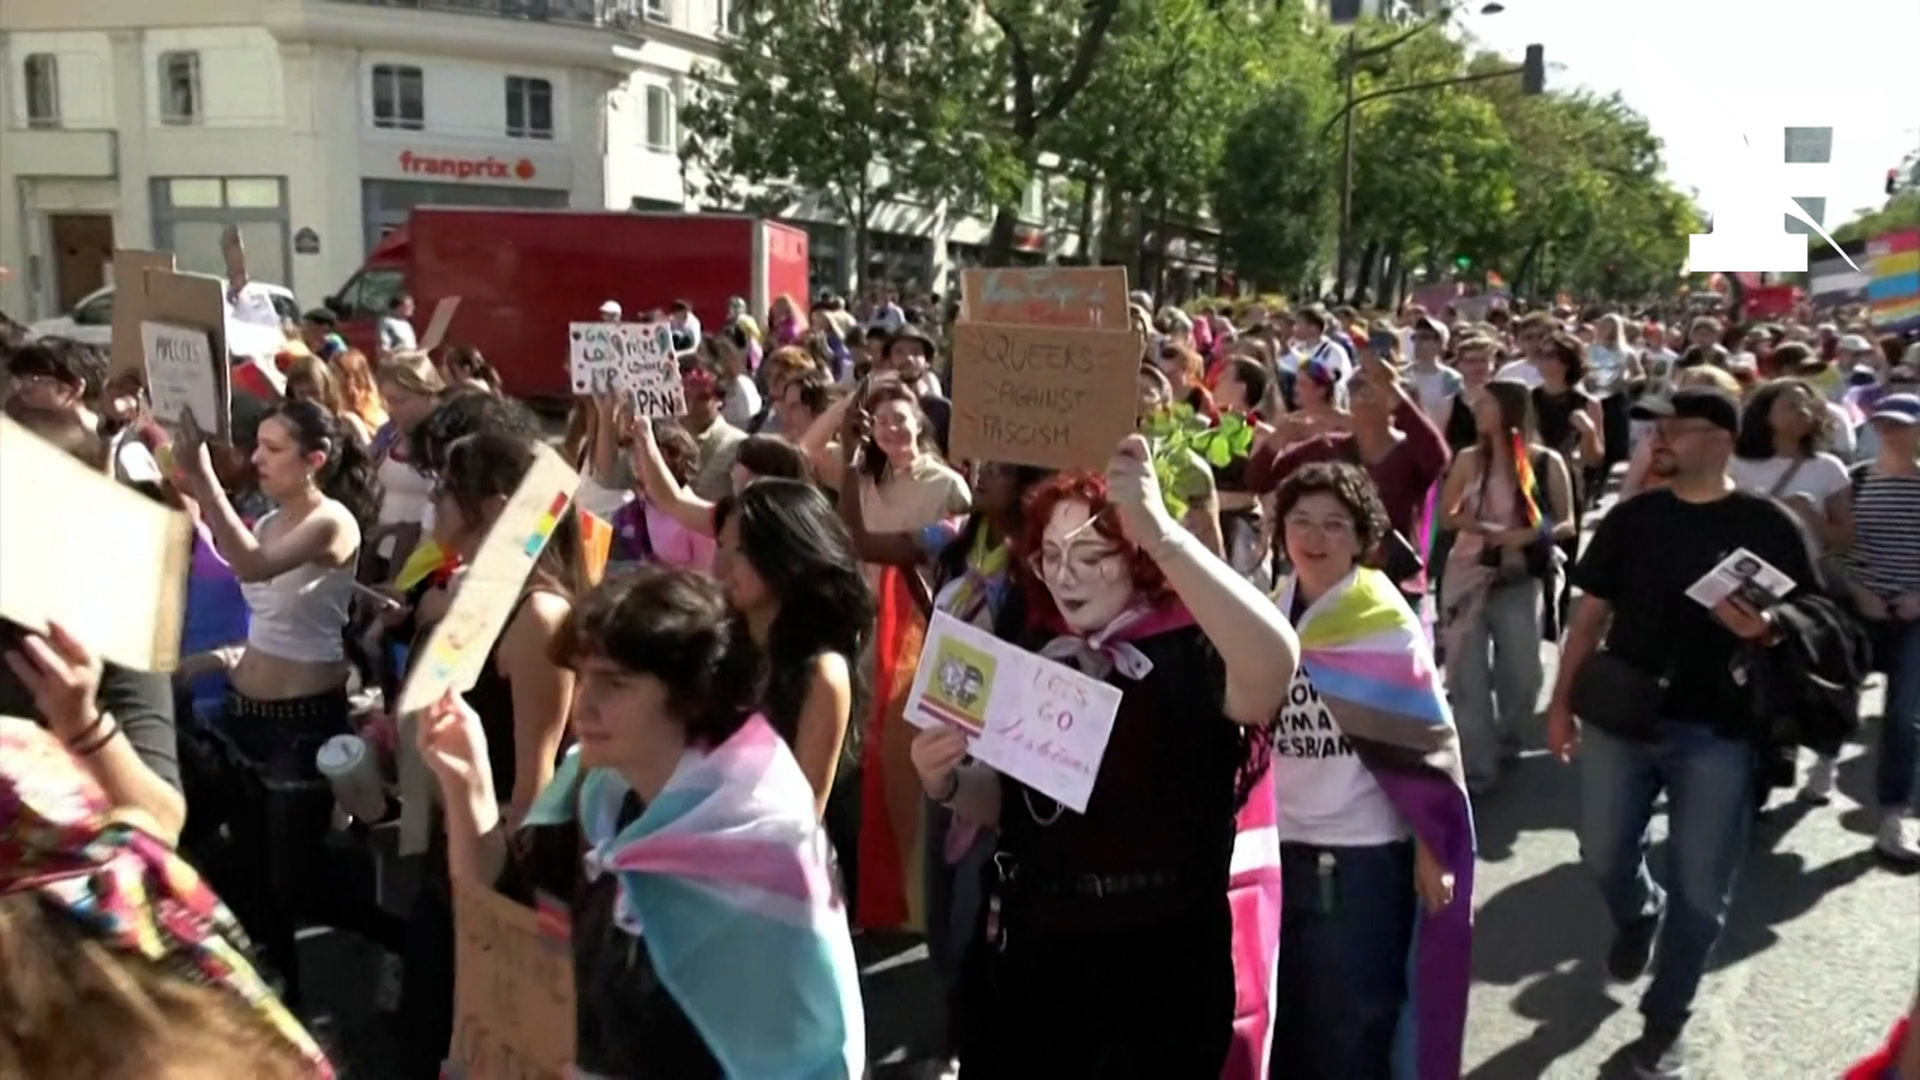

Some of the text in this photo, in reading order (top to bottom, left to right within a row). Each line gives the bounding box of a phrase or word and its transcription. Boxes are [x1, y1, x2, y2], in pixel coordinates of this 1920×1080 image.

[399, 150, 511, 179] franprix
[983, 334, 1095, 374] QUEERS
[637, 388, 675, 416] PAN
[1001, 379, 1087, 414] AGAINST
[982, 414, 1070, 447] FASCISM
[1038, 702, 1074, 732] GO
[1318, 709, 1333, 731] A
[1277, 735, 1354, 758] ESBIAN
